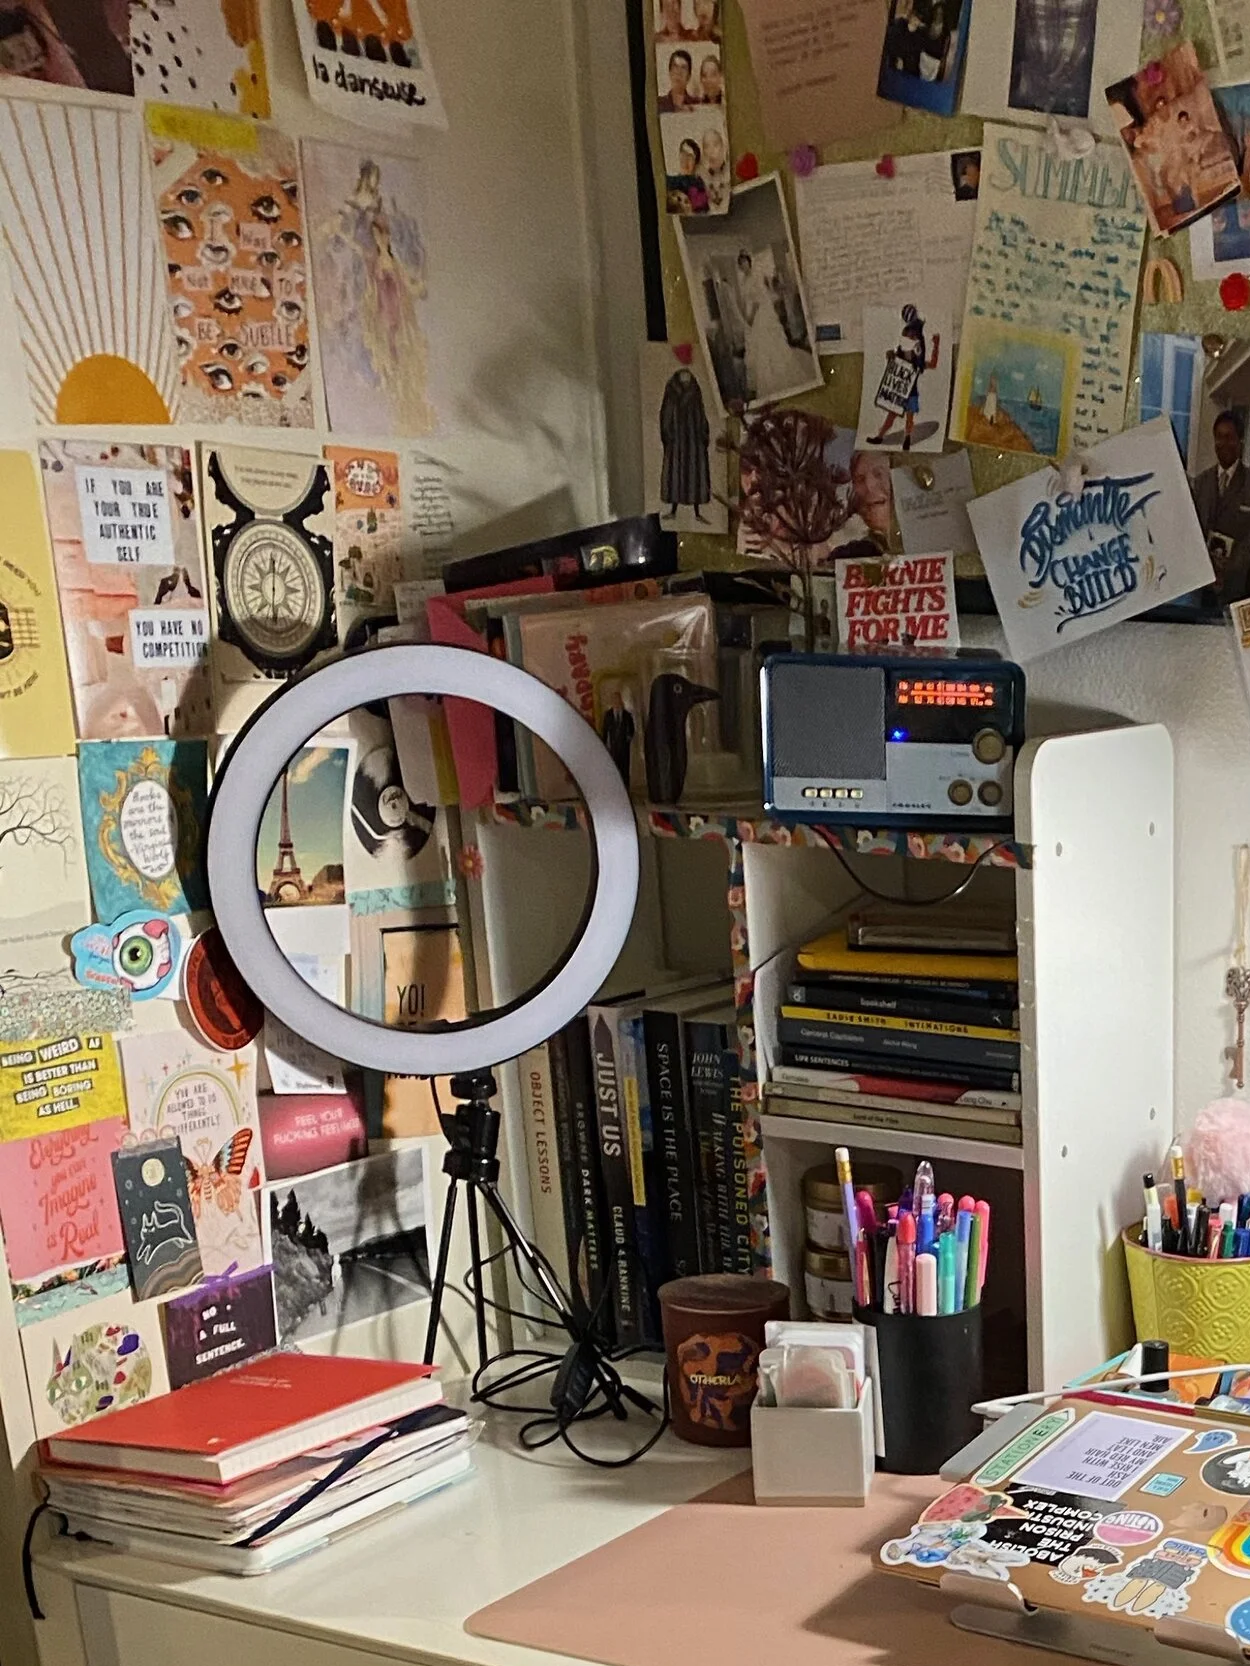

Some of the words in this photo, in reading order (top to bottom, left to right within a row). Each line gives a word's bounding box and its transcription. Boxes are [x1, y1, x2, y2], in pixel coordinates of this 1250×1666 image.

[312, 53, 330, 84] la
[335, 60, 427, 106] danseuse
[278, 278, 294, 296] TO
[884, 375, 910, 396] LIVES
[85, 477, 96, 493] IF
[112, 478, 133, 496] YOU
[145, 480, 165, 497] ARE
[93, 500, 121, 517] YOUR
[132, 503, 159, 519] TRUE
[99, 522, 157, 541] AUTHENTIC
[117, 545, 141, 562] SELF
[1050, 533, 1140, 588] CHANGE
[843, 557, 947, 589] BRNIE
[1064, 562, 1138, 614] BUILD
[845, 585, 946, 617] FIGHTS
[135, 619, 155, 637] YOU
[160, 619, 184, 637] HAVE
[191, 619, 203, 636] NO
[848, 617, 900, 649] FOR
[904, 614, 950, 641] ME
[397, 984, 425, 1018] YO!
[2, 1051, 34, 1067] BEING
[39, 1038, 80, 1061] WEIRD
[692, 1053, 722, 1064] JOHN
[23, 1072, 35, 1085] IS
[35, 1066, 69, 1082] BETTER
[69, 1059, 97, 1074] THAN
[656, 1043, 673, 1099] SPACE
[691, 1065, 724, 1079] LEWIS
[15, 1086, 48, 1104] BEING
[53, 1080, 92, 1097] BORING
[175, 1087, 189, 1100] YOU
[193, 1082, 208, 1094] ARE
[596, 1052, 618, 1119] JUST
[729, 1076, 742, 1112] THE
[530, 1072, 545, 1124] OBJECT
[38, 1105, 52, 1117] AS
[294, 1114, 318, 1127] FEEL
[661, 1104, 675, 1122] IS
[273, 1127, 318, 1145] FUCKING
[602, 1124, 621, 1157] US
[663, 1128, 678, 1161] THE
[535, 1132, 551, 1194] LESSONS
[732, 1121, 749, 1226] POISONED
[581, 1168, 592, 1205] DARK
[666, 1165, 683, 1223] PLACE
[717, 1183, 729, 1220] WITH
[60, 1208, 100, 1261] Real
[585, 1209, 599, 1270] MATTERS
[737, 1234, 752, 1275] CITY
[617, 1258, 631, 1312] RANKINE
[202, 1306, 217, 1321] NO
[213, 1321, 237, 1336] FULL
[985, 1416, 1064, 1480] STATIONERY
[1106, 1443, 1127, 1453] EAT
[1115, 1436, 1142, 1447] LIKE
[1139, 1441, 1165, 1451] MEN
[1081, 1456, 1110, 1468] WITH
[1084, 1447, 1111, 1459] HAIR
[1109, 1451, 1131, 1463] RED
[1130, 1457, 1148, 1466] MY
[1132, 1448, 1157, 1458] AND
[1065, 1470, 1087, 1481] THE
[1107, 1470, 1132, 1481] ASH
[1108, 1461, 1134, 1472] RISE
[1085, 1475, 1102, 1485] OF
[1099, 1478, 1122, 1488] OUT
[1022, 1499, 1104, 1521] COMPLEX
[1018, 1521, 1085, 1542] PRISON
[989, 1540, 1065, 1562] ABOLISH
[1037, 1537, 1073, 1553] THE
